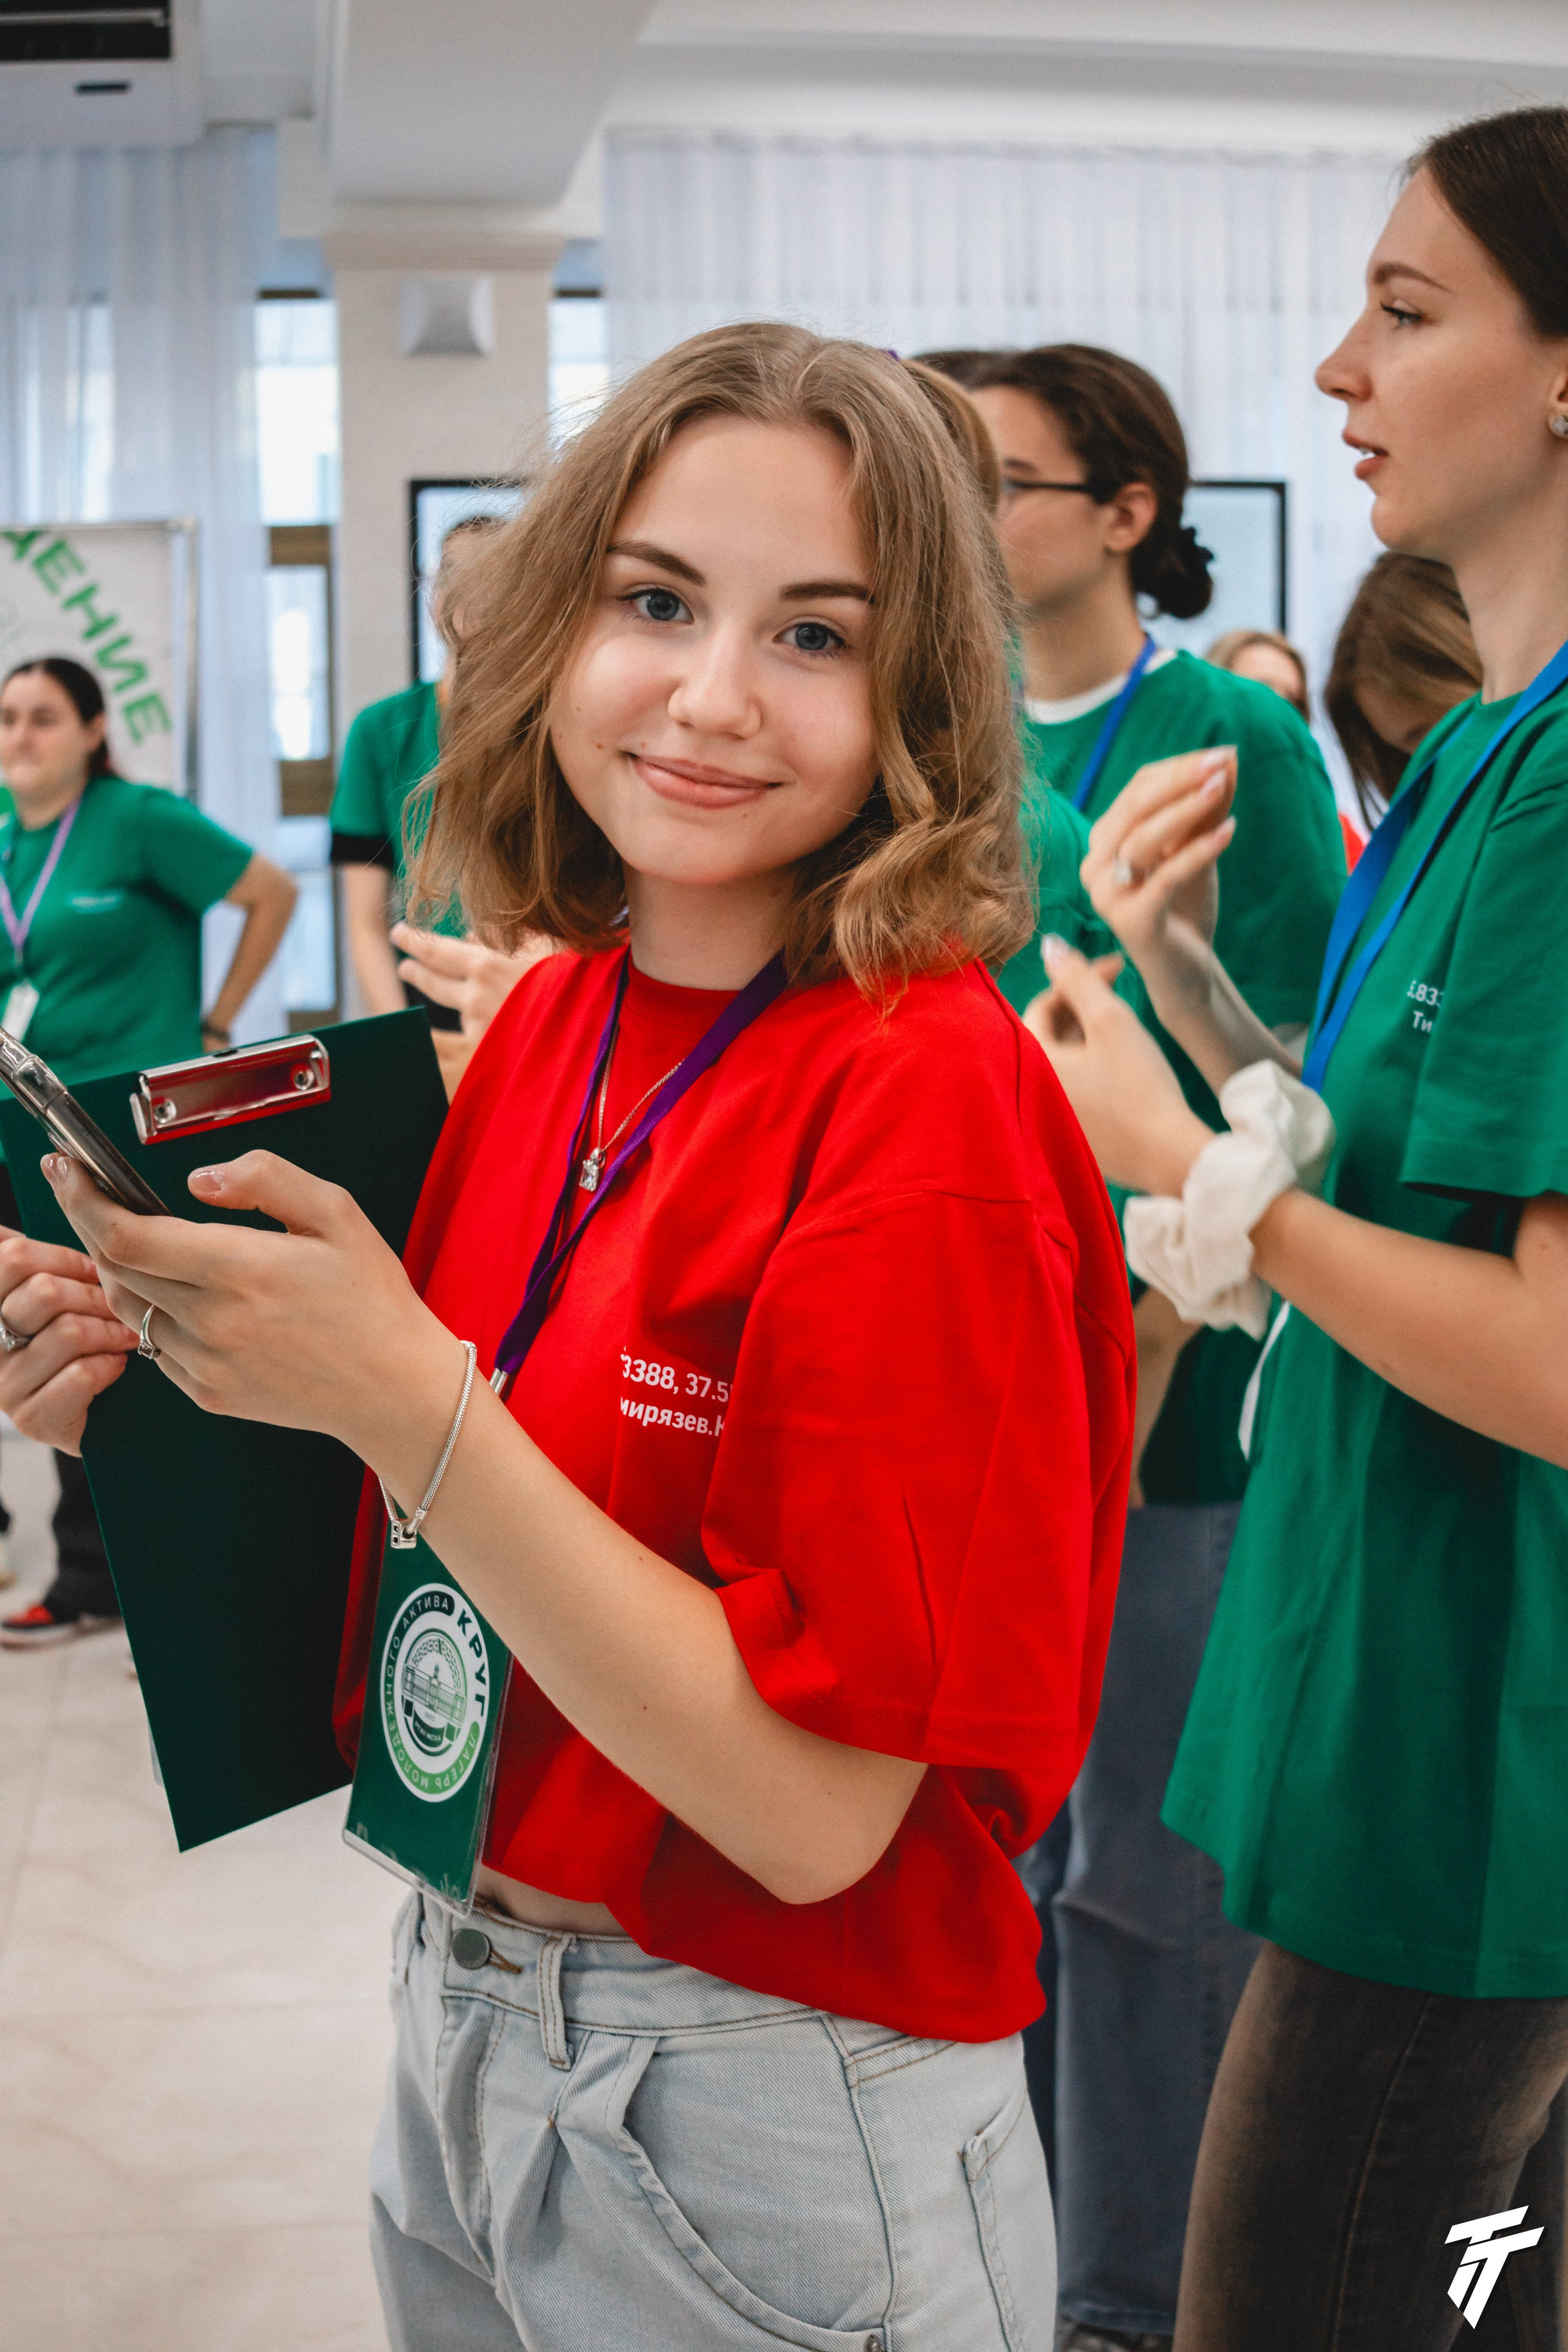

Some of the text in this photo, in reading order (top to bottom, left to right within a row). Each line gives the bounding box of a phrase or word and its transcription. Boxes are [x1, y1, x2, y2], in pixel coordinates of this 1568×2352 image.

[685, 1373, 733, 1403] 37.5
[402, 1594, 449, 1630] АКТИВА
[457, 1608, 486, 1717] КРУГ
[435, 1732, 475, 1789] ЛАГЕРЬ
